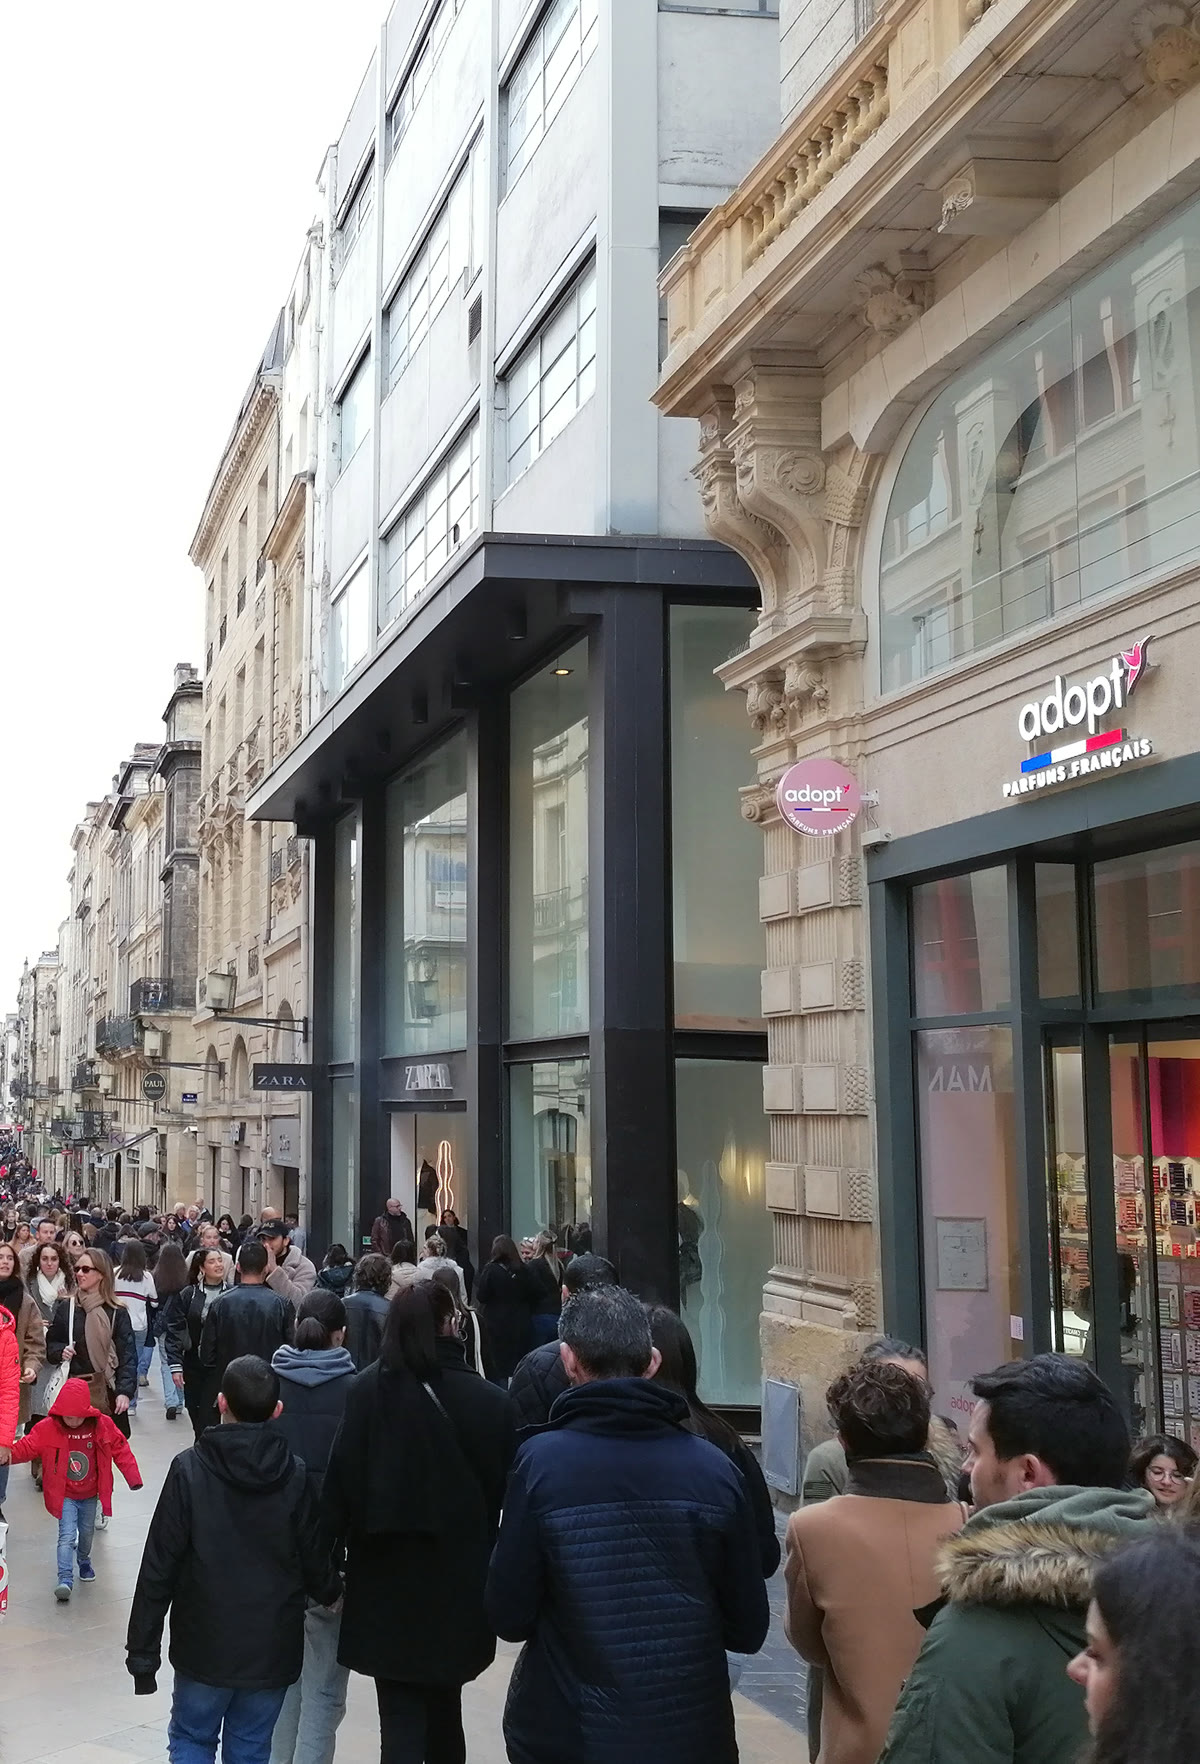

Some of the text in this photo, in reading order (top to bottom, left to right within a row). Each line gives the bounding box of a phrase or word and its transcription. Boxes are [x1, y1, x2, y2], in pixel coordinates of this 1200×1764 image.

[1018, 657, 1127, 742] adopt
[1002, 738, 1153, 798] PARFUMS FRANÇAIS
[785, 783, 843, 807] adopt
[788, 812, 856, 836] PARFUMS FRANÇAIS
[144, 1080, 165, 1088] PAUL
[257, 1076, 307, 1086] ZARA
[405, 1063, 453, 1090] ZARA
[951, 1395, 976, 1417] adop
